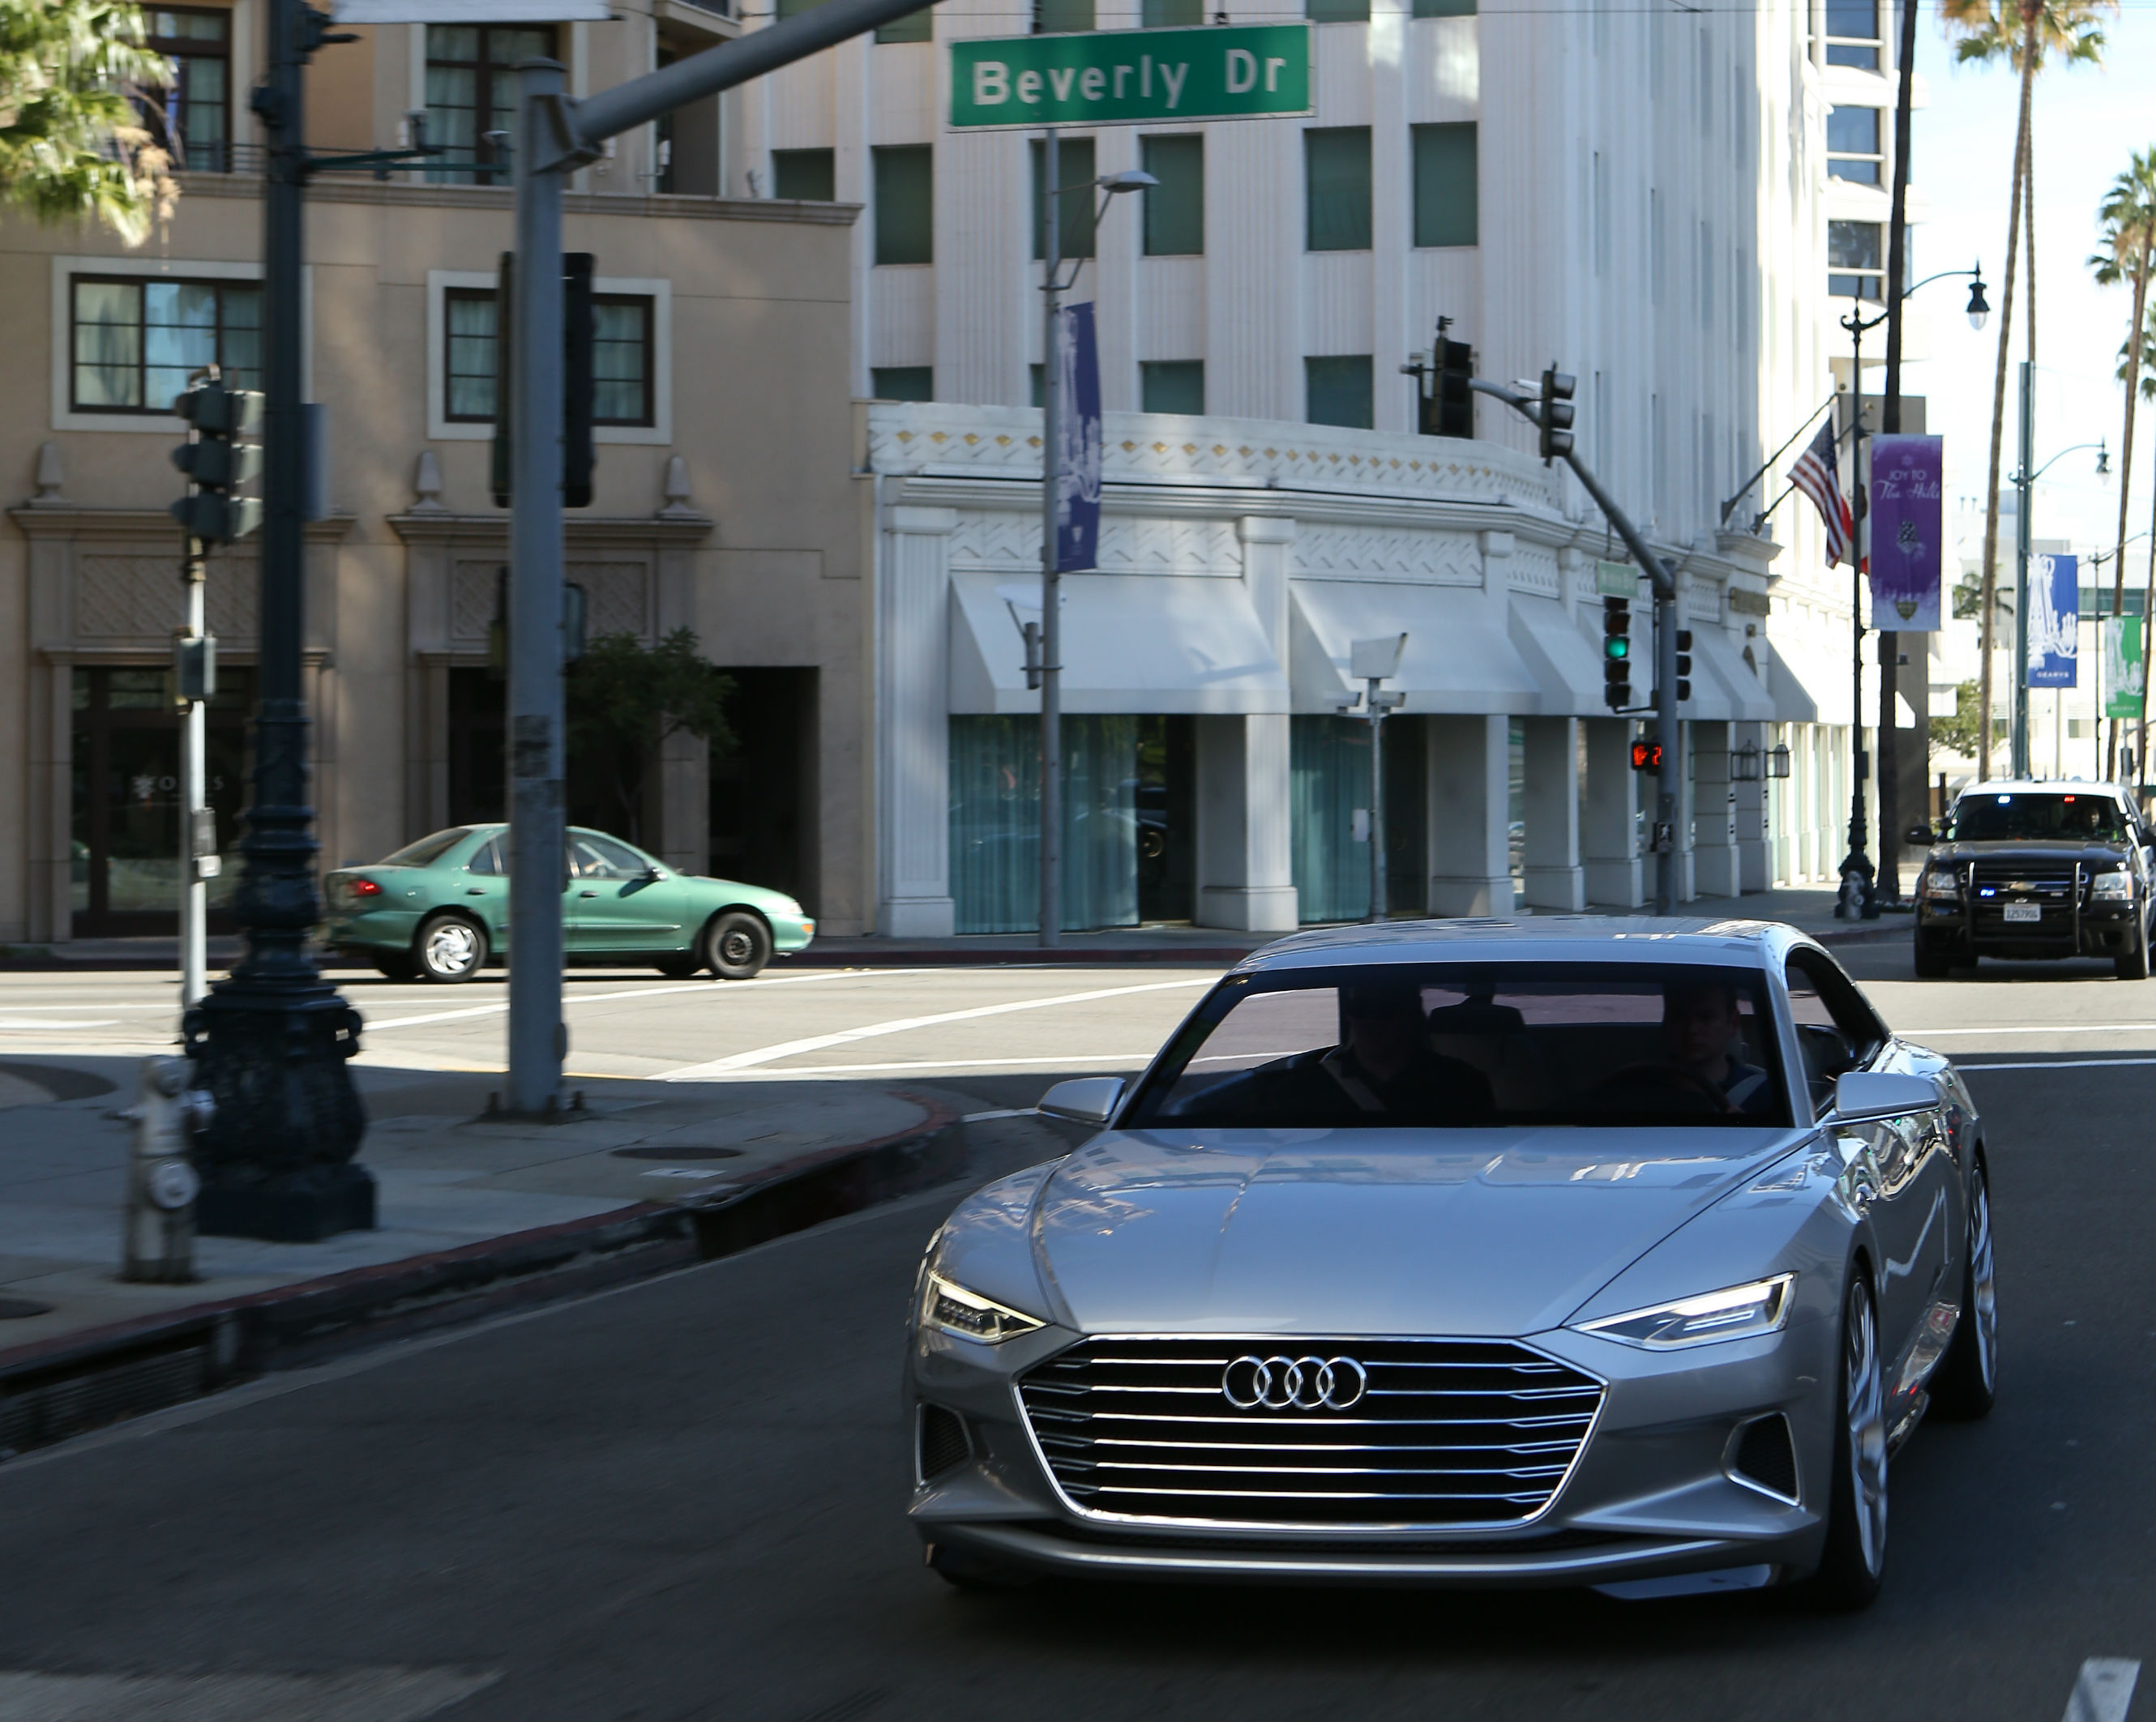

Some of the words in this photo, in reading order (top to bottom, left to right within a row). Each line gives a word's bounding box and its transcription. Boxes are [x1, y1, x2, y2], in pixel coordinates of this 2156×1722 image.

[973, 54, 1189, 109] Beverly
[1226, 49, 1286, 94] Dr
[1911, 469, 1927, 481] TO
